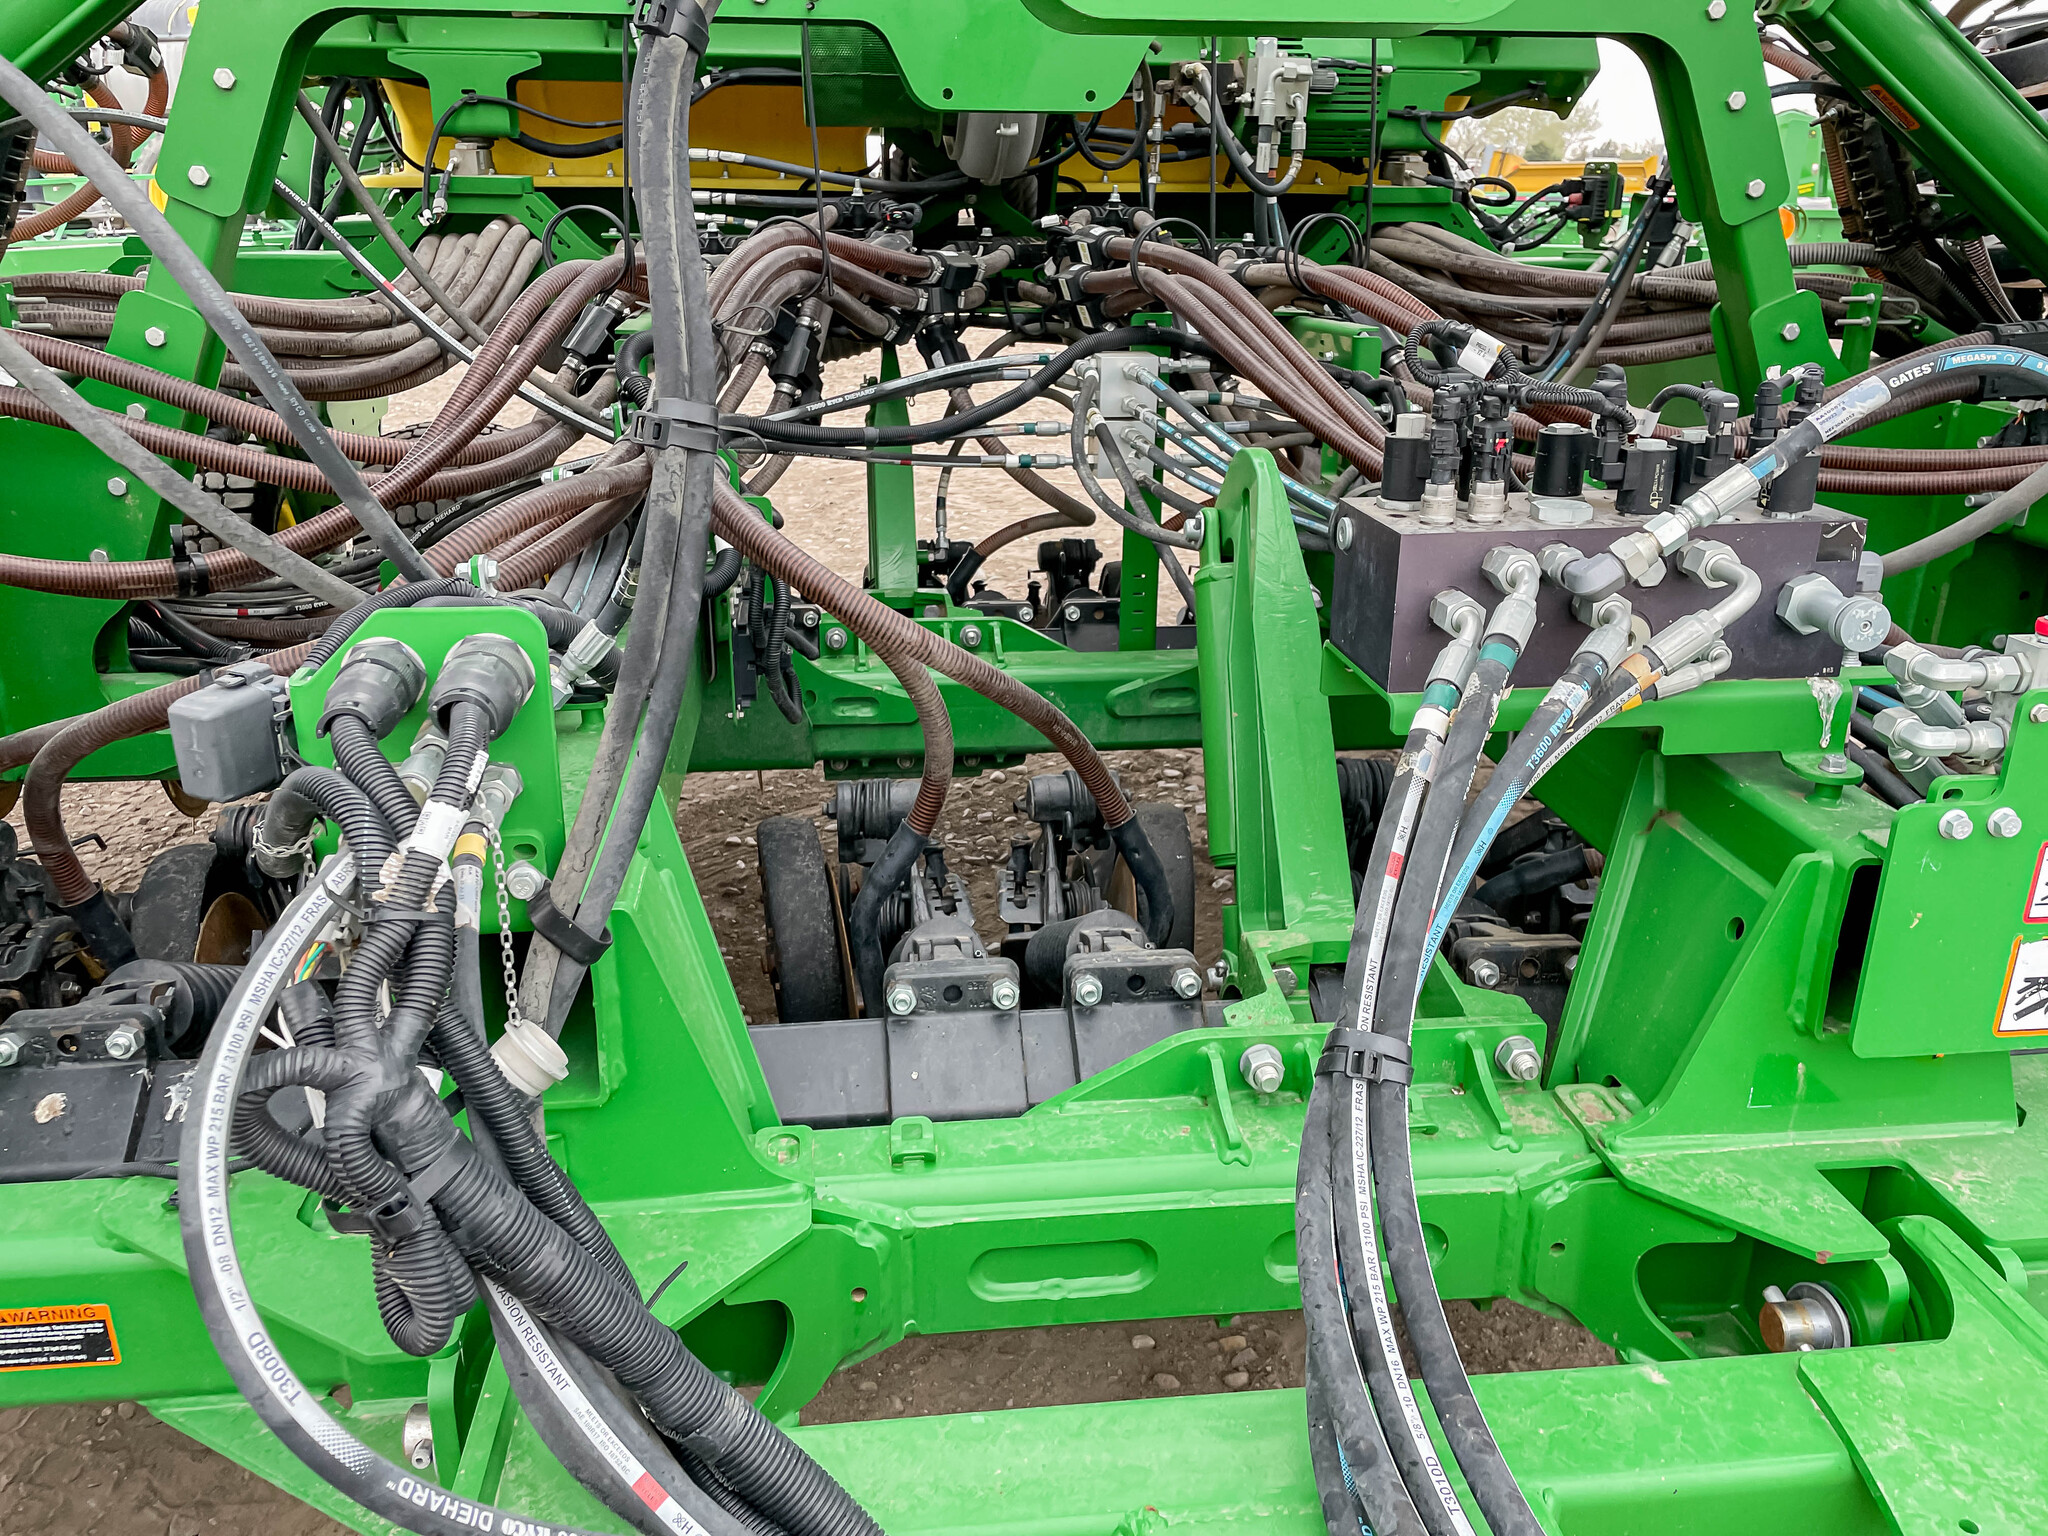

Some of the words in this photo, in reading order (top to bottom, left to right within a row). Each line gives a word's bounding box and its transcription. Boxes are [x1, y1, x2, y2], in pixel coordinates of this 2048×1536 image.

[274, 178, 307, 207] DIEHARD
[1888, 361, 1936, 389] GATES
[1952, 353, 1997, 365] MEGASys
[806, 402, 826, 412] T3000
[826, 397, 843, 407] RYCO
[845, 387, 876, 401] DIEHARD
[434, 503, 463, 524] DIEHARD
[294, 602, 313, 612] T3000
[1526, 735, 1553, 770] T3600
[1549, 708, 1573, 738] RYCO
[1541, 760, 1554, 774] PSI
[1554, 741, 1575, 760] MSHA
[1605, 697, 1627, 716] FRAS
[301, 894, 328, 924] FRAS
[271, 924, 305, 973] IC-227/12
[249, 970, 277, 1006] MSHA
[1362, 958, 1379, 1016] RESISTANT
[224, 1033, 246, 1063] 3100
[214, 1073, 231, 1104] BAR
[1355, 1083, 1365, 1111] FRAS
[210, 1104, 225, 1131] 215
[205, 1137, 221, 1160] WP
[1355, 1117, 1365, 1160] IC-227/12
[205, 1164, 220, 1198] MAX
[1357, 1163, 1367, 1194] MSHA
[1360, 1201, 1369, 1219] PSI
[208, 1207, 227, 1247] DN12
[1362, 1222, 1374, 1248] 3100
[1367, 1256, 1379, 1281] BAR
[1372, 1284, 1383, 1304] 215
[8, 1307, 96, 1322] WARNING
[1377, 1307, 1389, 1325] WP
[1383, 1328, 1397, 1354] MAX
[247, 1331, 302, 1407] T3008D
[521, 1327, 571, 1392] RESISTANT
[1391, 1359, 1407, 1390] DN16
[585, 1408, 602, 1429] MEETS
[600, 1427, 609, 1438] OR
[607, 1435, 631, 1463] EXCEEDS
[1425, 1456, 1461, 1516] T3010D
